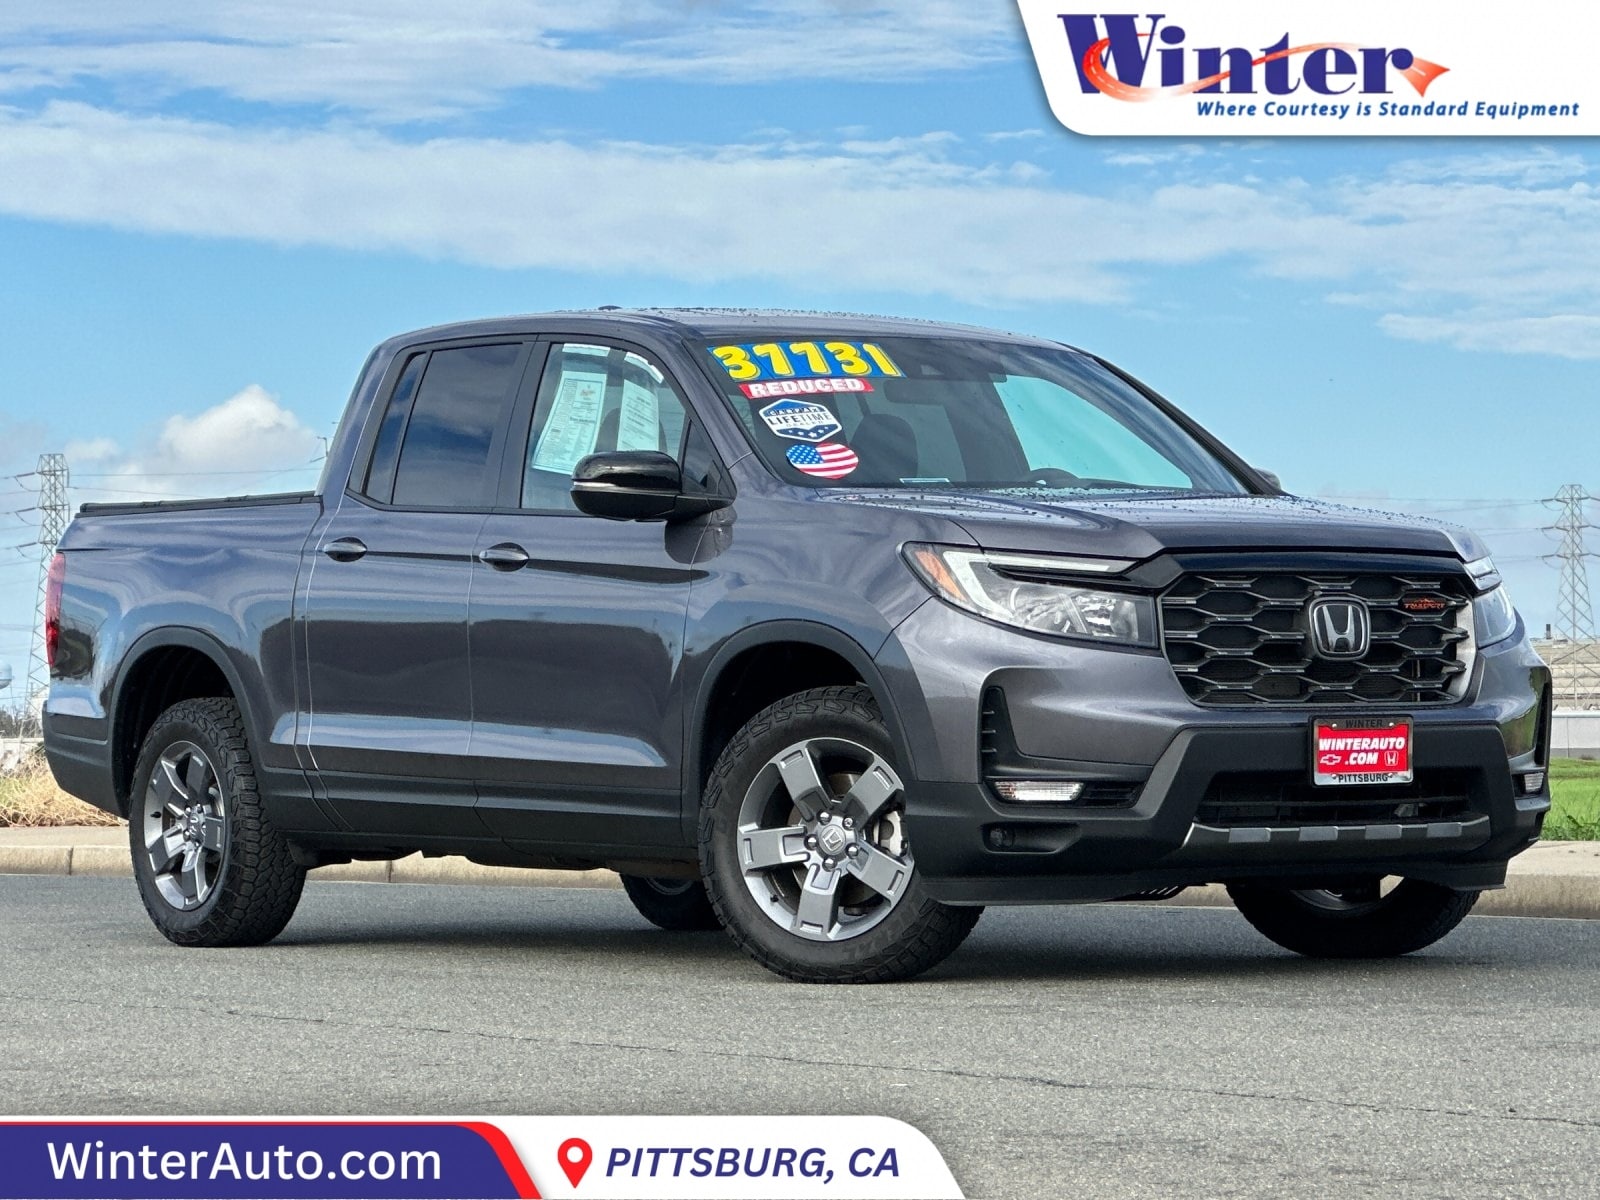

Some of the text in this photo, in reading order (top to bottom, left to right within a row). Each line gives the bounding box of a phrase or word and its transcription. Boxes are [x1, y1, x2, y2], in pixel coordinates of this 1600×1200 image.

[713, 342, 901, 379] 37731
[748, 379, 865, 398] REDUCED
[767, 413, 832, 425] LIFETIME
[1345, 719, 1383, 729] WINTER
[1319, 736, 1406, 751] WINTERAUTO
[1344, 752, 1379, 766] .COM
[1338, 772, 1389, 783] PITTSBURG
